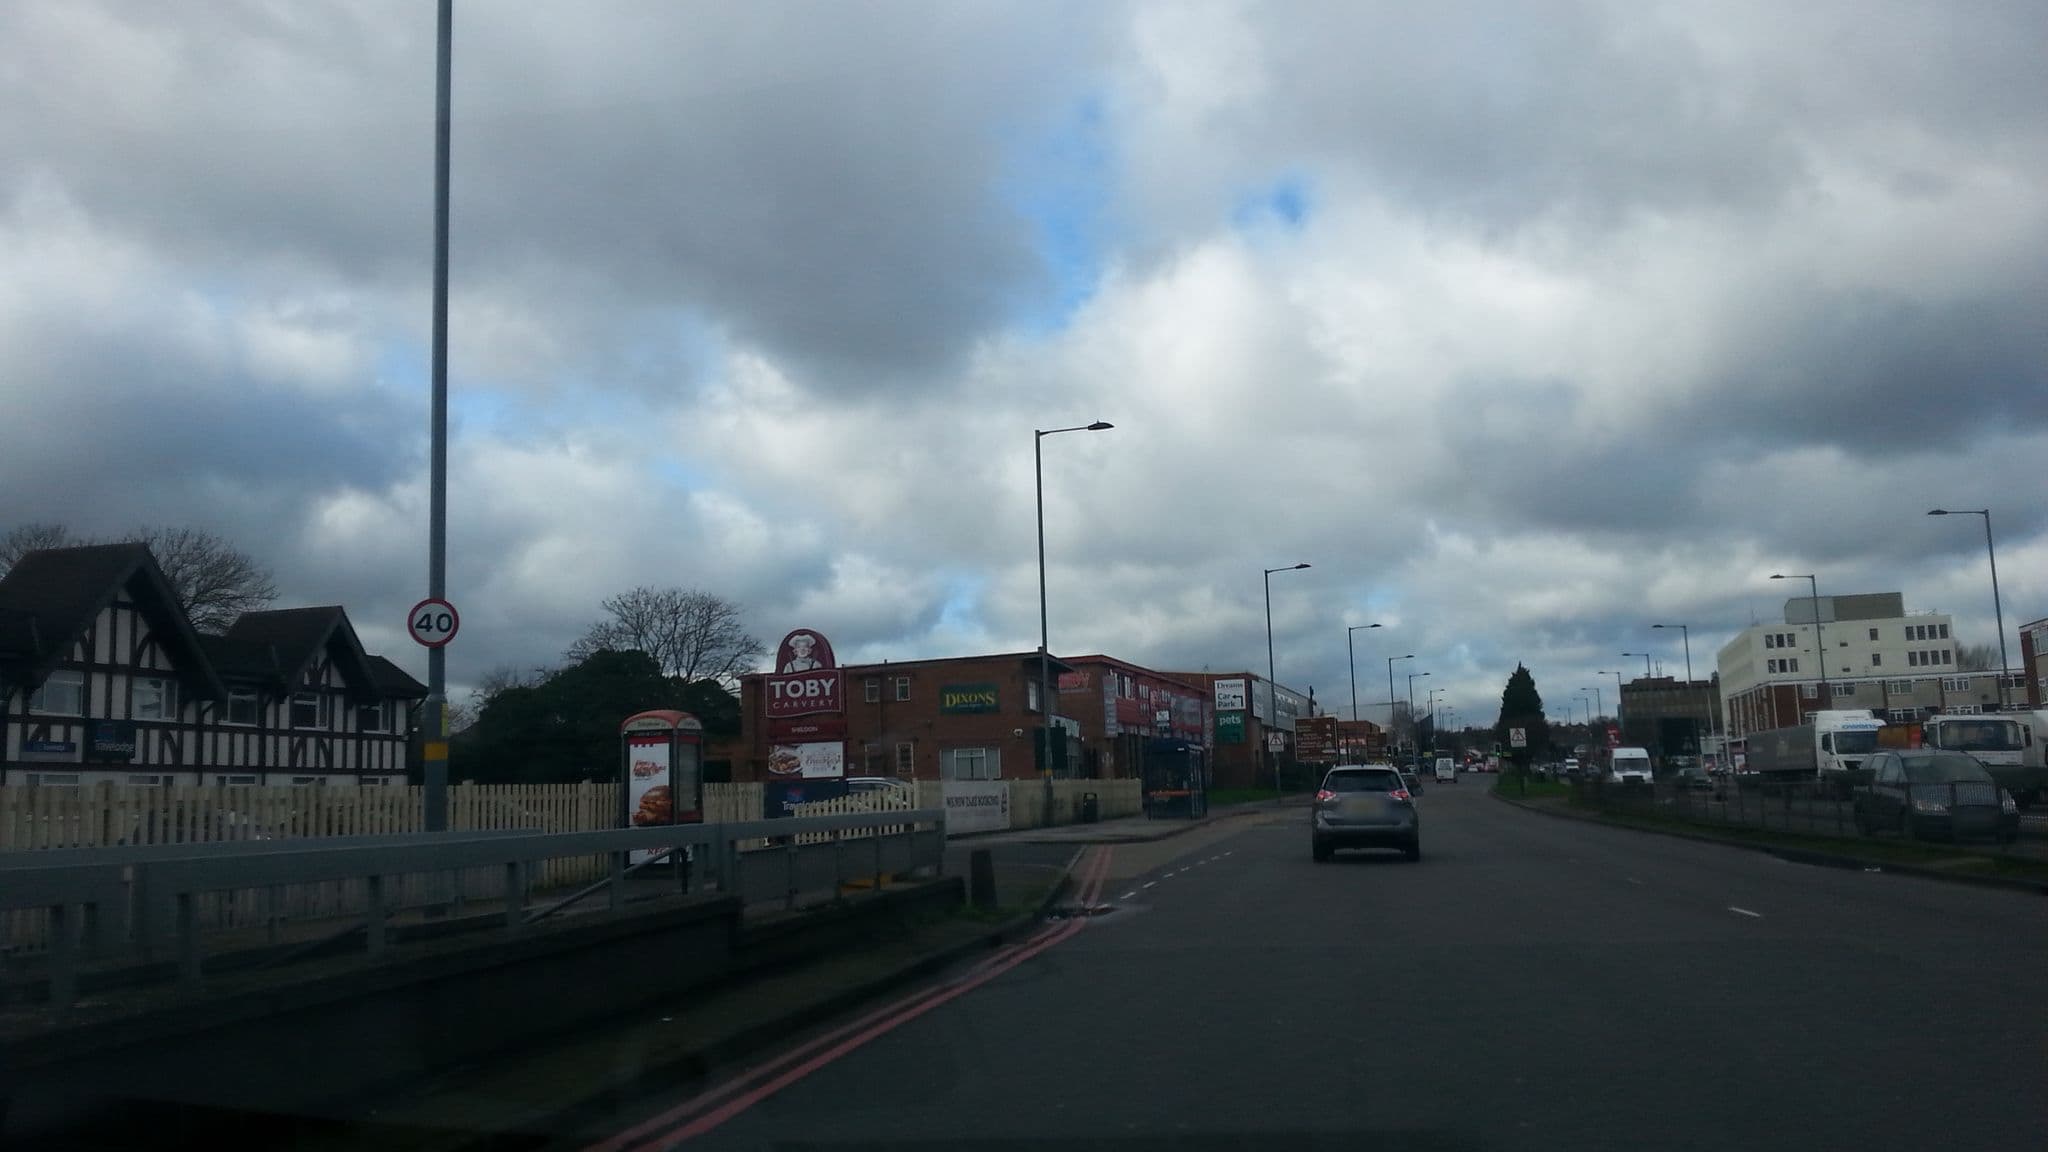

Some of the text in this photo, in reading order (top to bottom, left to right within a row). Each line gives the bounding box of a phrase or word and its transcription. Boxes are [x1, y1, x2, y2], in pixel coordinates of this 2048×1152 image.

[415, 613, 452, 632] 40
[770, 678, 836, 699] TOBY
[773, 699, 834, 709] CARVERY
[944, 692, 996, 708] DIXONS
[1219, 715, 1241, 727] pets
